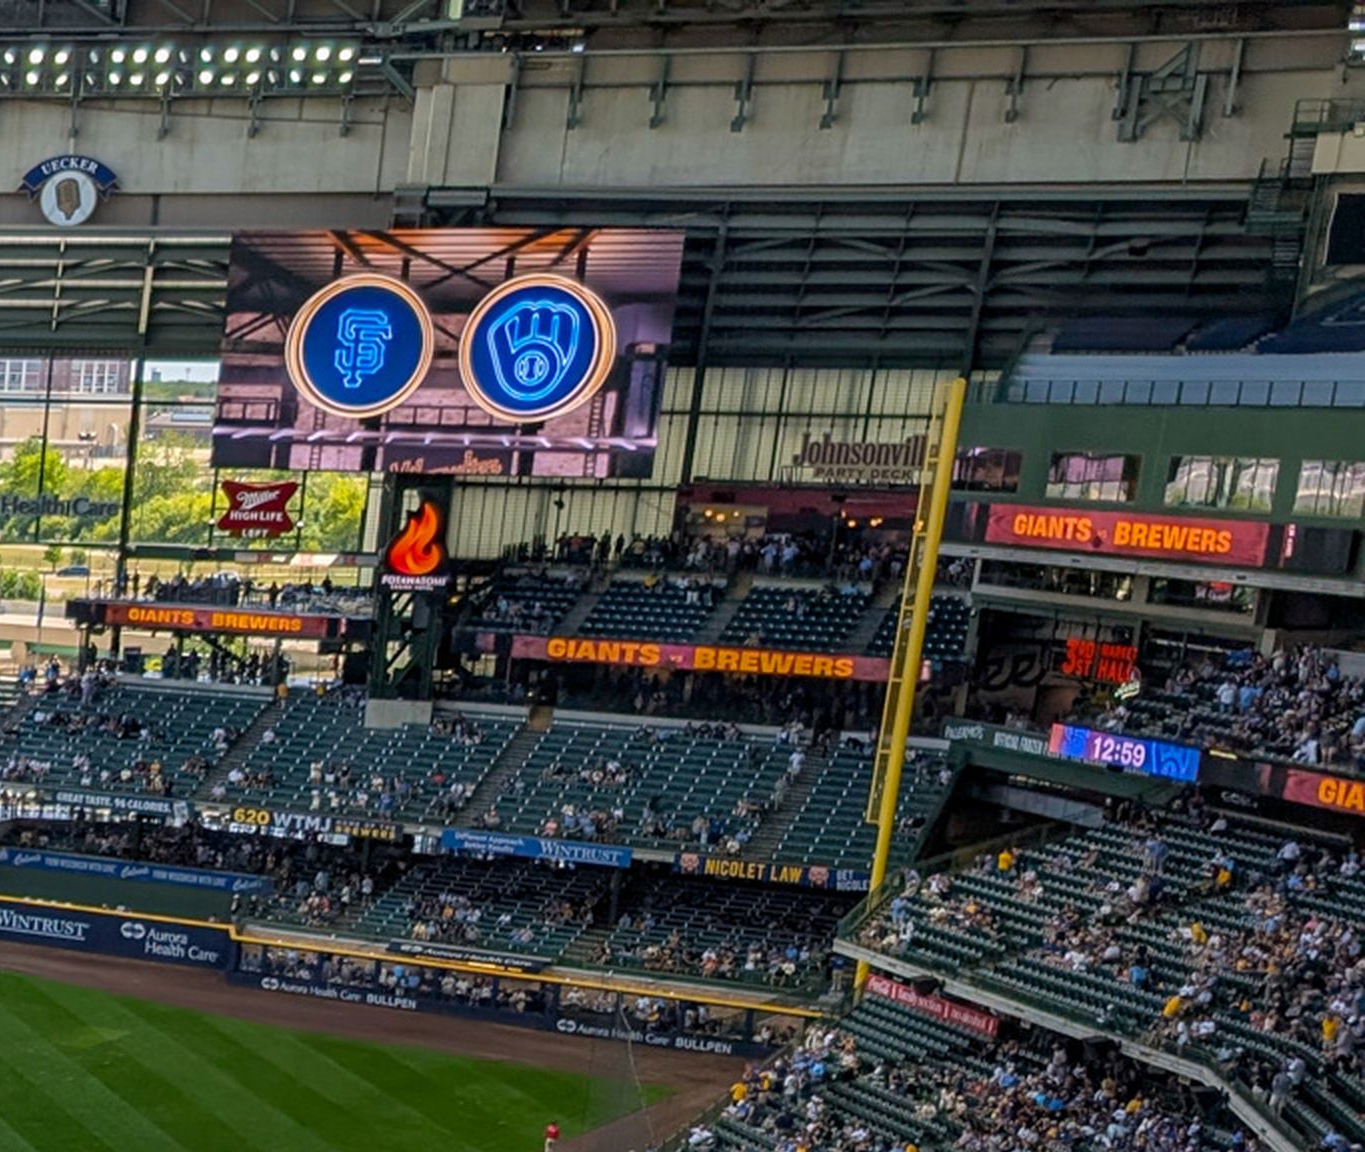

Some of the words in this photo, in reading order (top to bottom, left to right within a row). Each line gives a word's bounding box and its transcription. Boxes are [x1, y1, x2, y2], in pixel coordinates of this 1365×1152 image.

[40, 156, 99, 176] UECKER
[793, 433, 933, 467] Johnsonvill
[814, 466, 867, 479] PARTY
[871, 468, 912, 480] DECK
[72, 499, 119, 516] Care
[229, 511, 258, 521] HIGH
[259, 511, 284, 522] LIFE
[1013, 513, 1092, 541] GIANTS
[1113, 521, 1232, 553] BREWERS
[127, 607, 195, 625] GIANTS
[211, 611, 302, 632] BREWERS
[546, 637, 661, 665] GIANTS
[692, 647, 854, 677] BREWERS
[1092, 735, 1146, 768] 12:59
[56, 791, 84, 804] GREAT
[233, 807, 270, 826] 620
[272, 812, 332, 833] WTMJ
[704, 857, 766, 880] NICOLET
[770, 864, 803, 883] LAW
[836, 879, 871, 891] NICOLE
[145, 927, 189, 945] Aurora
[144, 940, 186, 958] Health
[188, 944, 219, 963] Care
[279, 982, 307, 995] Aurora
[309, 984, 339, 999] Health
[340, 988, 362, 1001] Care
[366, 992, 417, 1010] BULLPEN
[577, 1022, 610, 1038] Aurora
[645, 1031, 670, 1047] Care
[674, 1035, 733, 1056] BULLPEN
